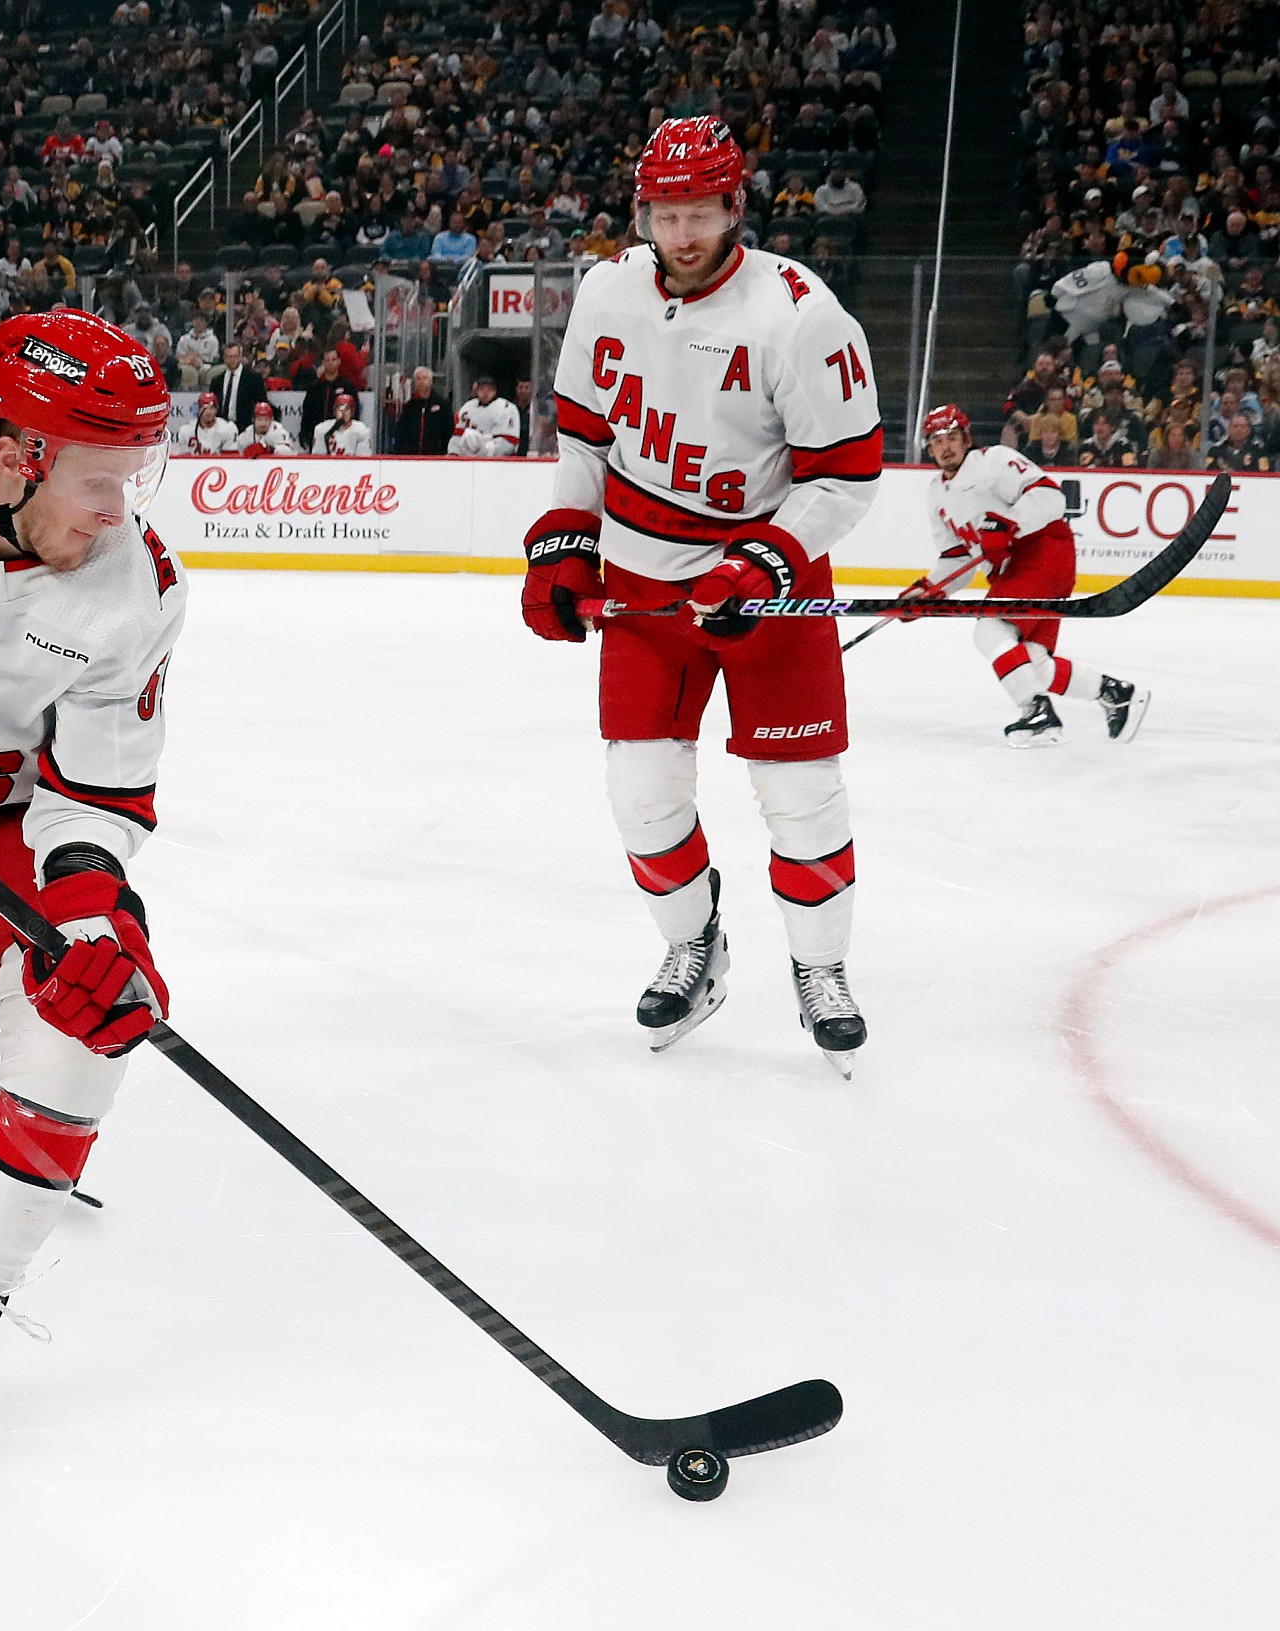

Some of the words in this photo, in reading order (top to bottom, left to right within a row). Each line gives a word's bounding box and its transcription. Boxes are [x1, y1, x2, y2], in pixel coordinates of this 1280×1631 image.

[667, 143, 687, 160] 74
[23, 341, 87, 379] Lenovo
[689, 343, 730, 355] NUCOR
[720, 345, 751, 392] A
[825, 342, 867, 402] 74
[592, 335, 747, 513] CANES
[191, 466, 399, 515] Caliente
[203, 522, 249, 538] Pizza
[255, 523, 271, 538] &
[278, 521, 327, 539] Draft
[332, 522, 390, 539] House
[25, 632, 90, 664] NUCOR
[752, 719, 834, 739] BAUER
